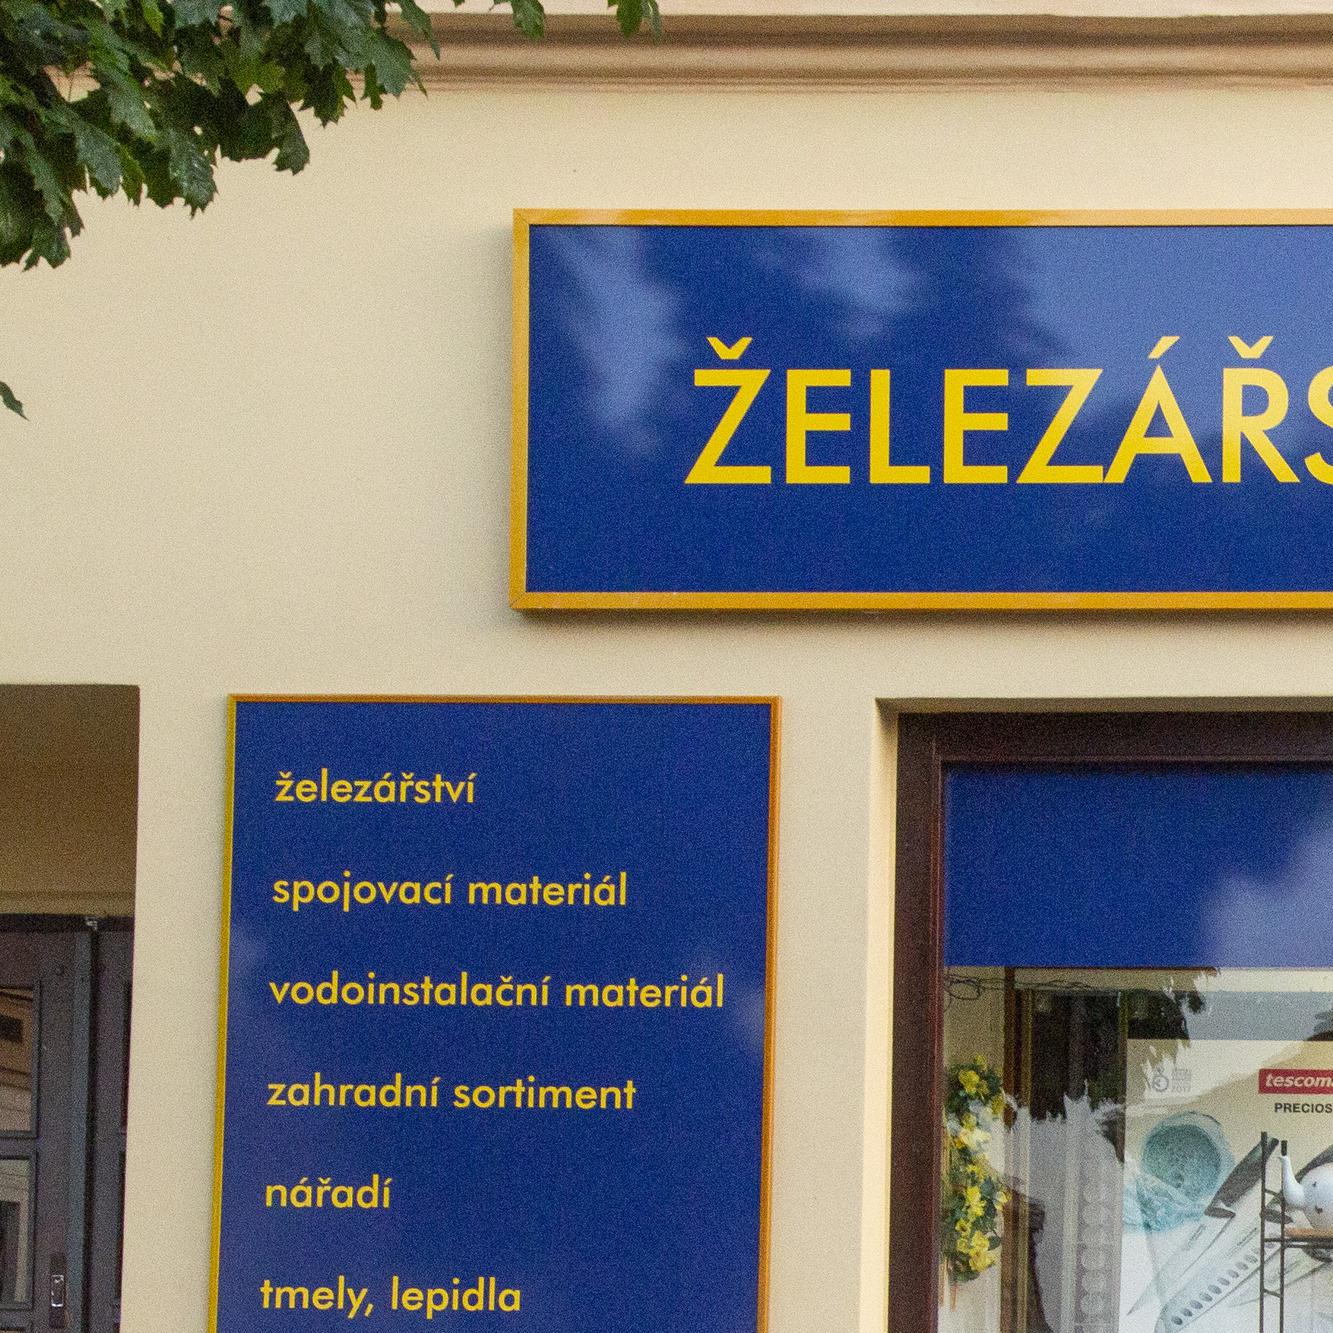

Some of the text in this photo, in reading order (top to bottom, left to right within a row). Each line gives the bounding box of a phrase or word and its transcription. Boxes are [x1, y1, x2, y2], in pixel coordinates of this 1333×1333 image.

[276, 768, 478, 805] železářství
[273, 871, 628, 914] spojovací materiál
[270, 971, 725, 1010] vodoinstalační materiál
[268, 1072, 638, 1111] zahradní sortiment
[265, 1174, 393, 1210] nářadí
[260, 1275, 522, 1321] tmely, lepidla
